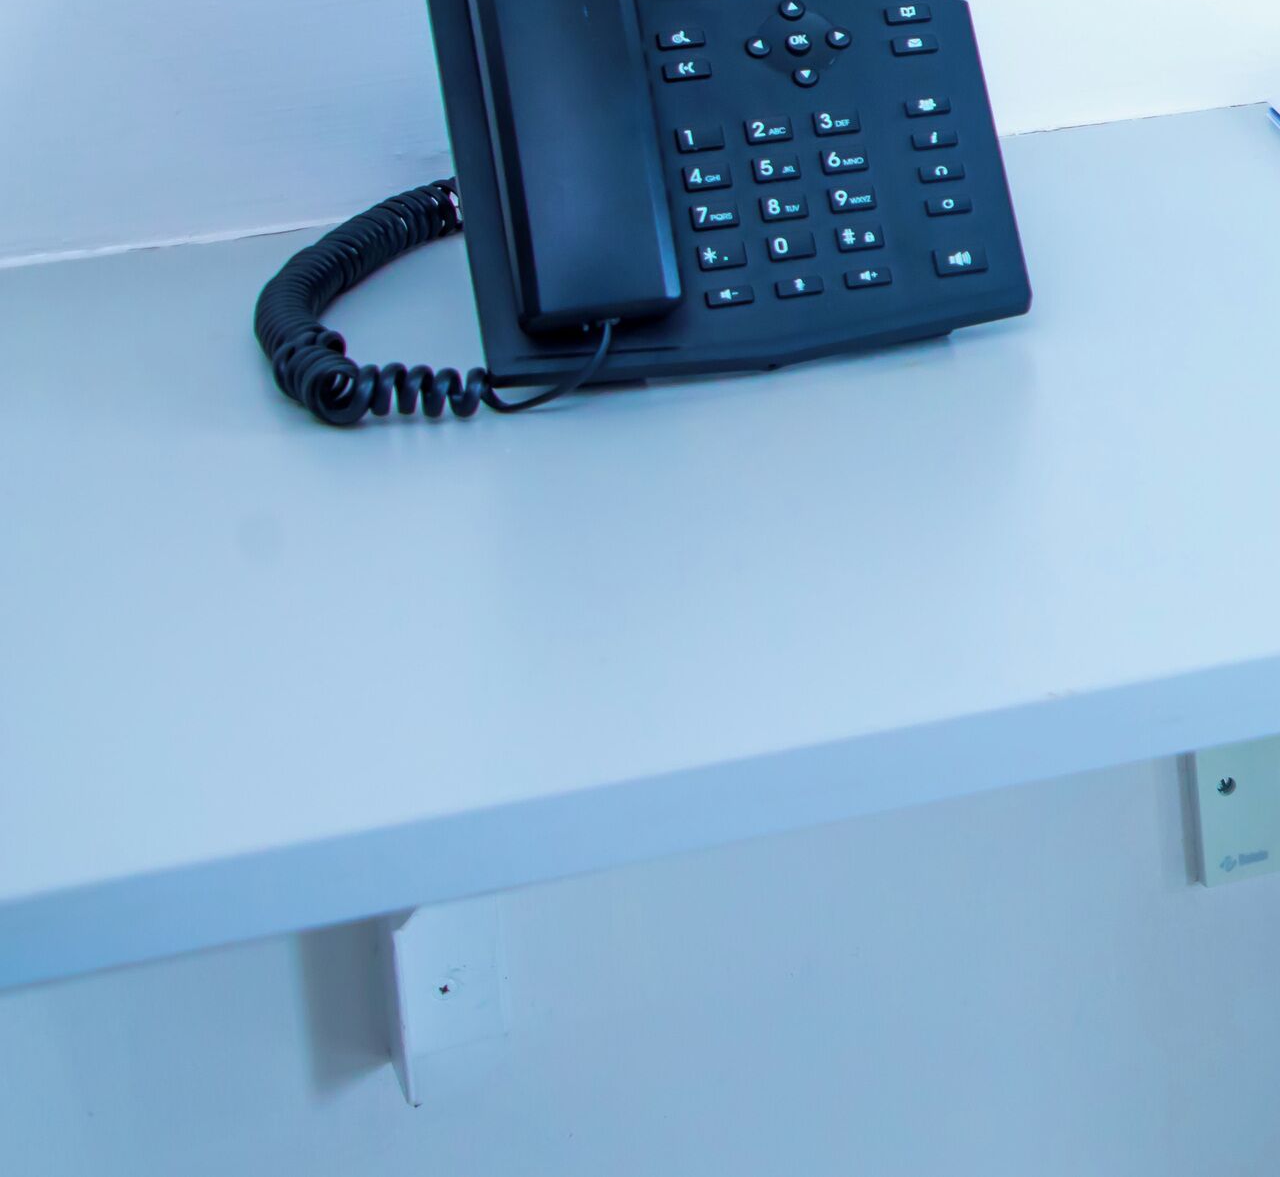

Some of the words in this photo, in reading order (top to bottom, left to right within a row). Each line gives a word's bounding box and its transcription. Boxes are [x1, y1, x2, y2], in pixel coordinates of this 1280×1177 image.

[789, 34, 808, 46] OK
[752, 121, 766, 138] 2
[768, 126, 787, 136] ABC
[820, 113, 833, 129] 3
[834, 118, 851, 128] DEF
[684, 129, 695, 146] 1
[760, 159, 774, 176] 5
[827, 151, 841, 168] 6
[842, 156, 865, 166] MNO
[689, 168, 703, 184] 4
[705, 174, 721, 183] GHI
[767, 198, 781, 215] 8
[784, 204, 801, 213] TUV
[834, 190, 849, 206] 9
[696, 206, 709, 223] 7
[710, 212, 733, 222] PQRS
[773, 237, 789, 254] 0
